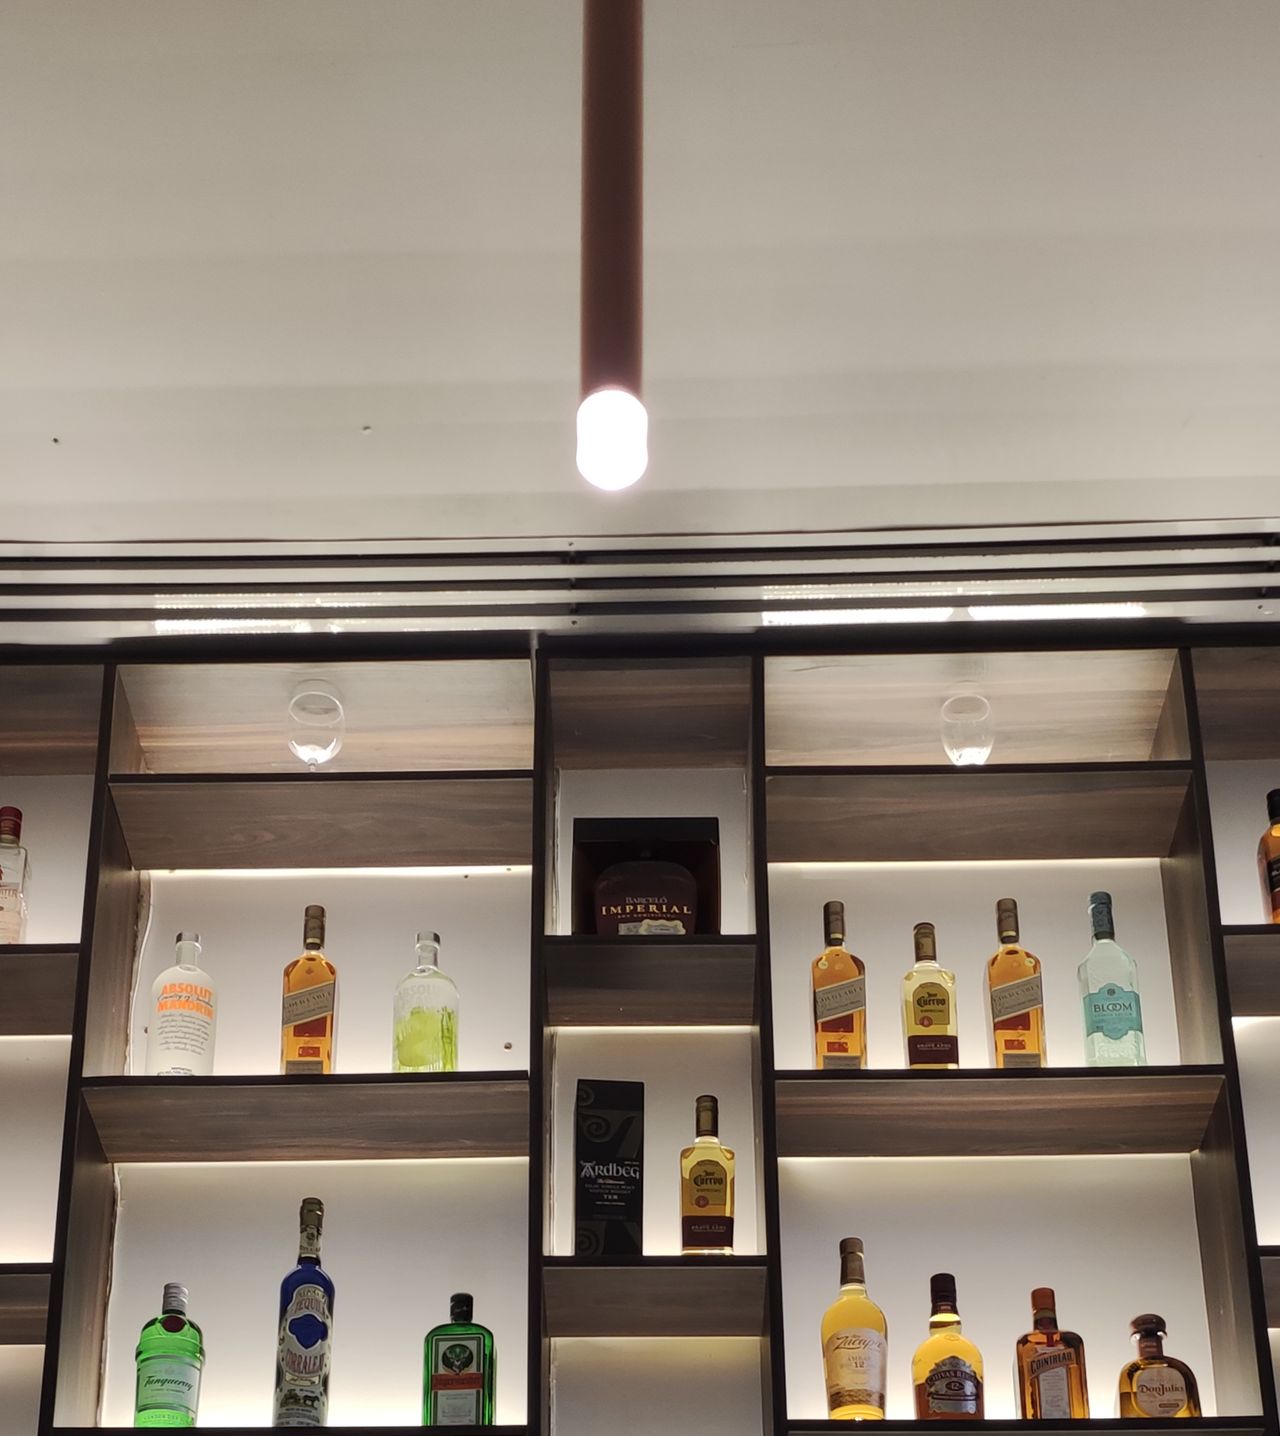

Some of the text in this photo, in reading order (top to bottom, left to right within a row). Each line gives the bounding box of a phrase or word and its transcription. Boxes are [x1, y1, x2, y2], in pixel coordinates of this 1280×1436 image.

[602, 904, 693, 916] IMPERIAL
[1093, 1002, 1133, 1013] BLOOM
[1030, 1352, 1073, 1374] COINTREAU
[143, 1375, 194, 1391] Tanqueray
